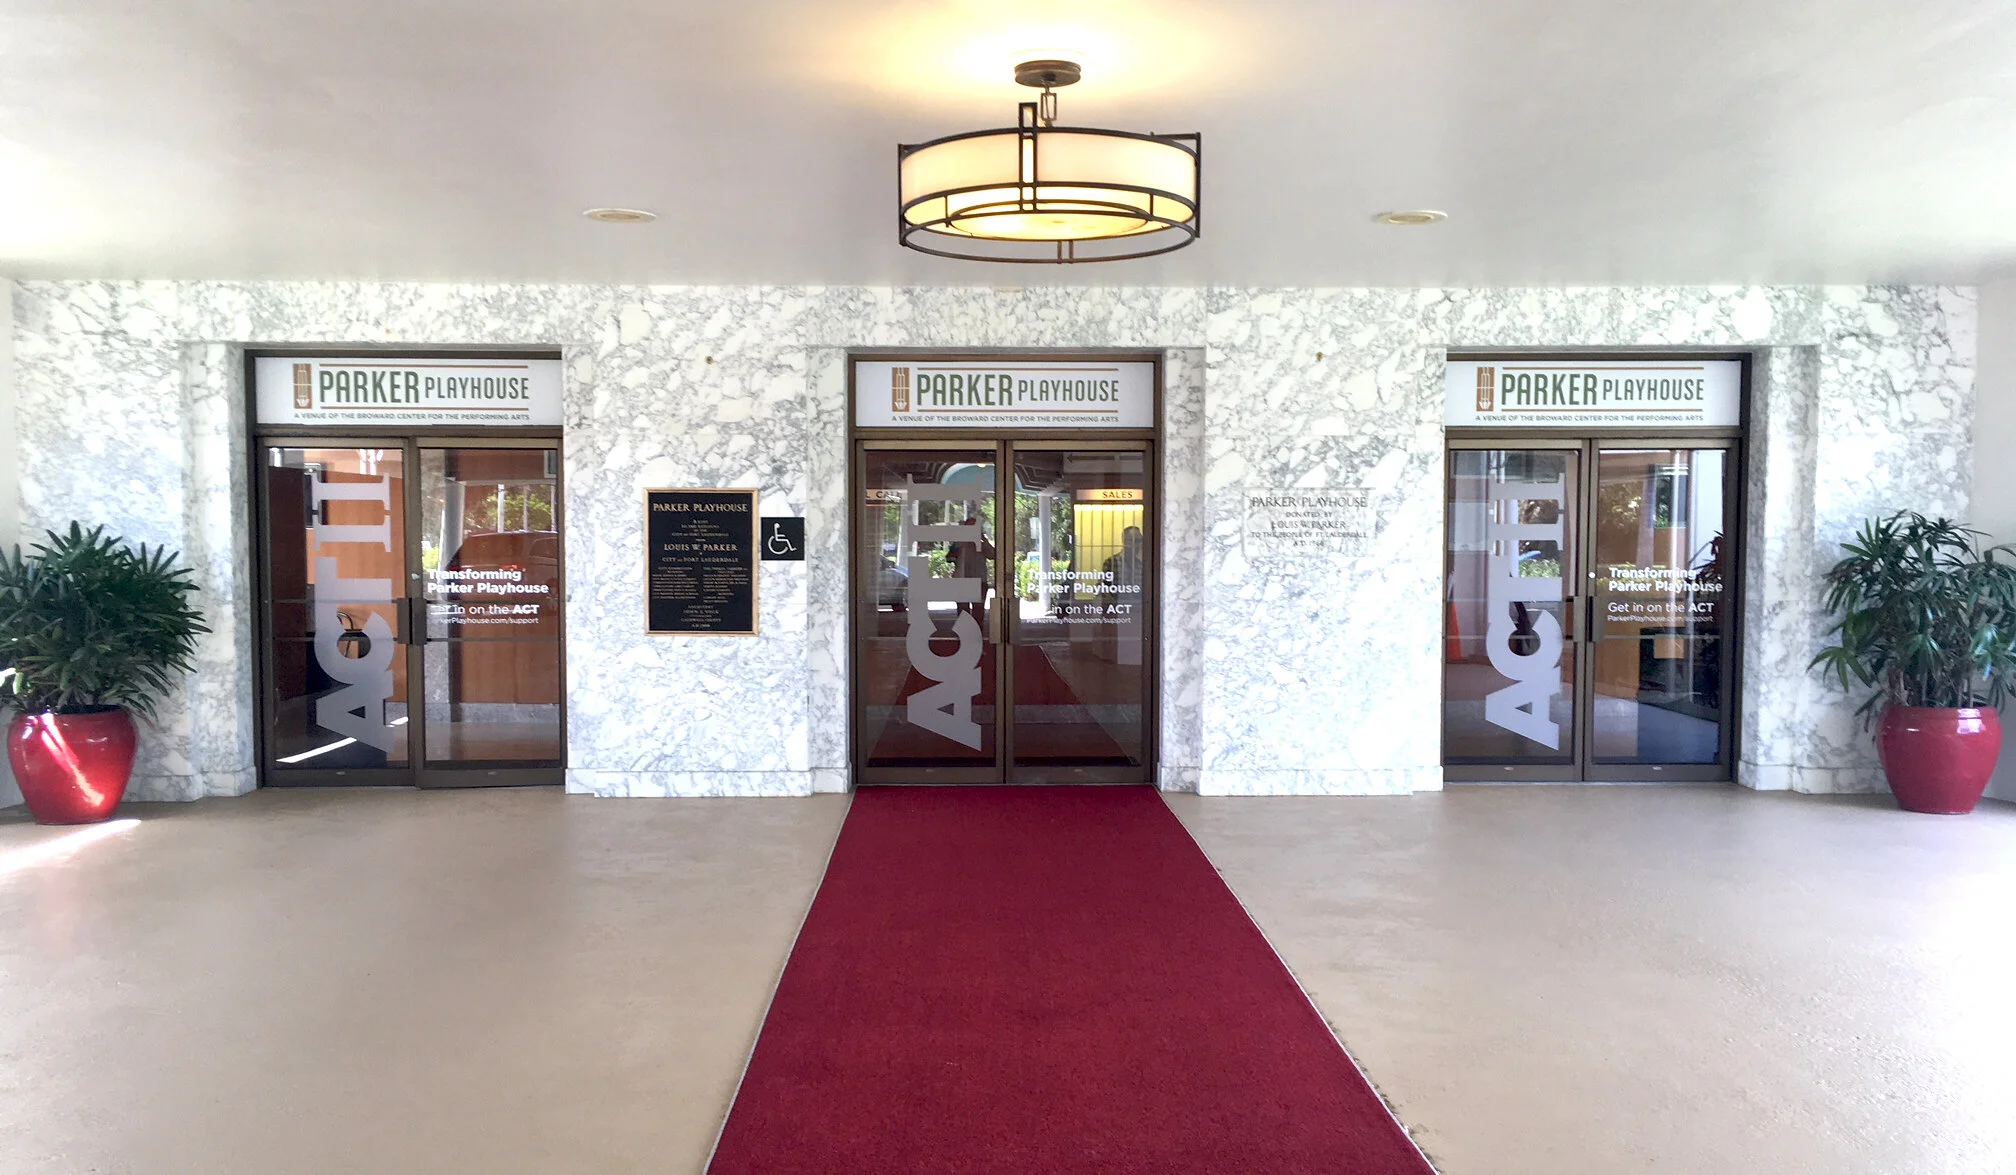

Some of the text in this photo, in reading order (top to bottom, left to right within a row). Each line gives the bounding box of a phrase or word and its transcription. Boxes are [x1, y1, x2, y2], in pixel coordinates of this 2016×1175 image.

[319, 370, 529, 403] PARKER PLAYHOUSE
[917, 373, 1119, 406] PARKER PLAYHOUSE
[1501, 373, 1704, 405] PARKER PLAYHOUSE
[1102, 491, 1133, 499] SALES
[653, 503, 748, 512] PARKER PLAYHOUSE
[1252, 497, 1368, 508] PARKER PLAYHOUSE
[1271, 521, 1298, 529] LOUIS
[1311, 520, 1346, 529] PARKER
[429, 568, 522, 581] Transforming
[1028, 568, 1114, 581] Transforming
[1608, 567, 1697, 580] Transforming
[427, 582, 549, 595] Parker Playhouse
[1027, 583, 1140, 595] Parker Playhouse
[1608, 581, 1723, 593] Parker Playhouse
[469, 606, 485, 614] on
[488, 604, 509, 614] the
[512, 605, 540, 614] ACT
[1052, 604, 1132, 614] in on the ACT
[1608, 602, 1714, 612] Get in on the ACT
